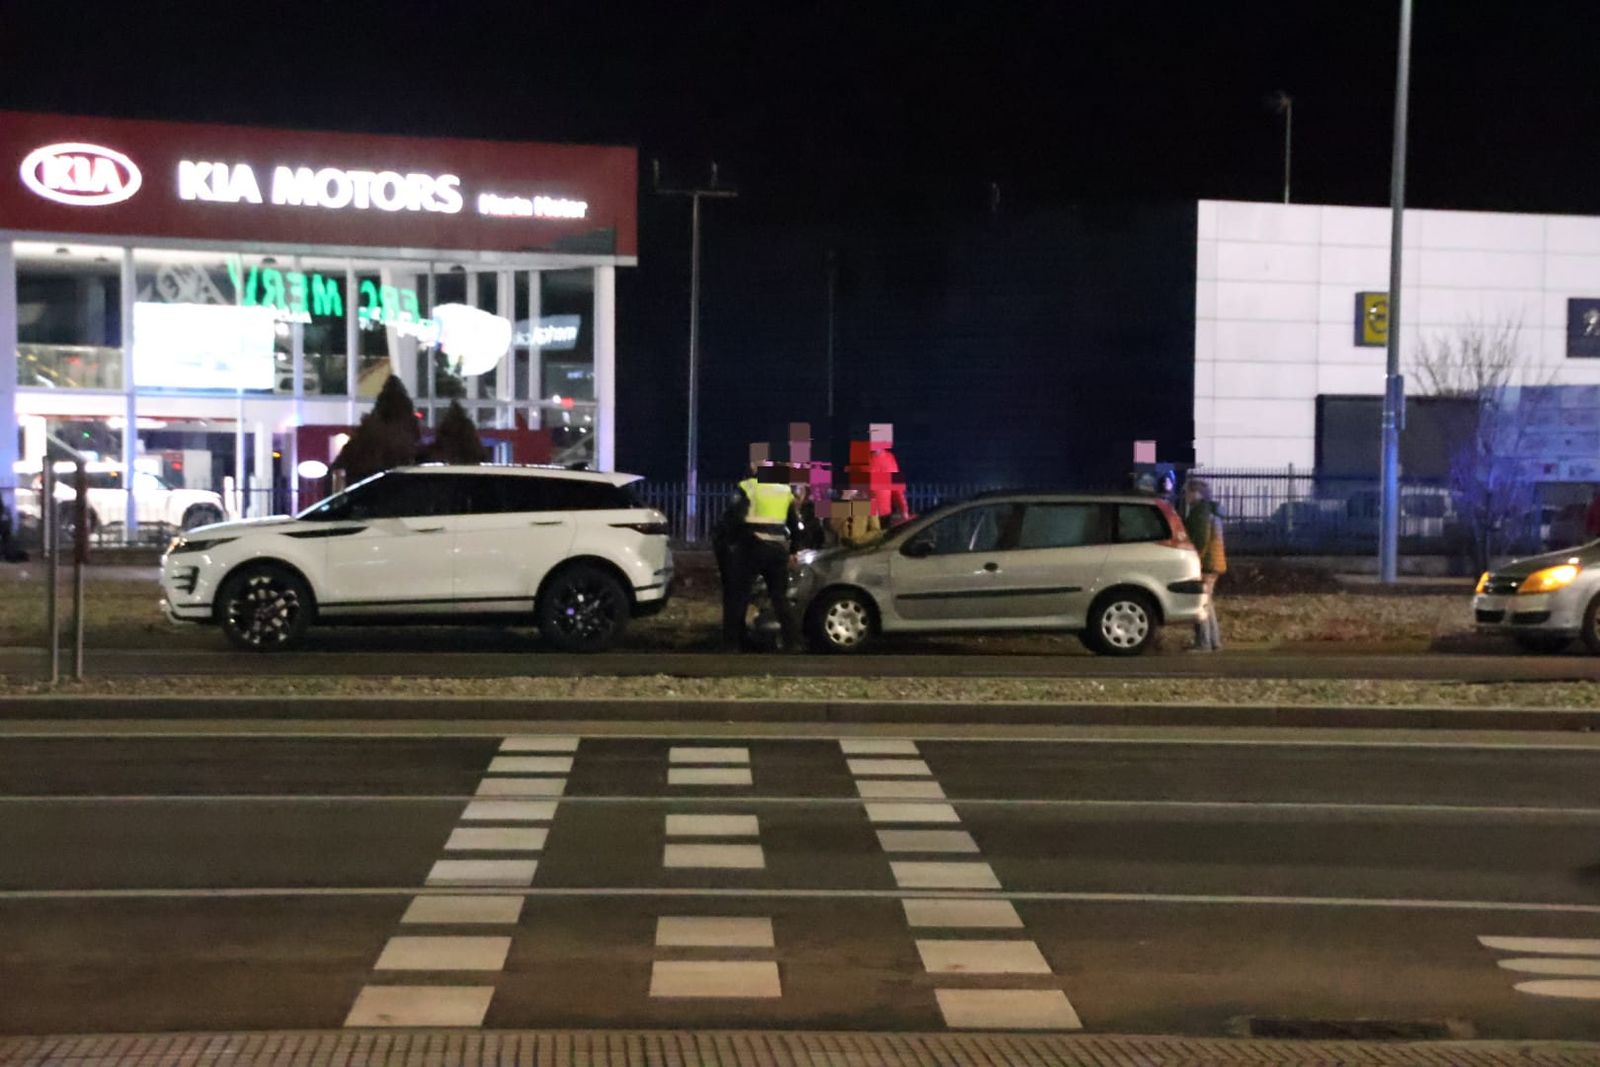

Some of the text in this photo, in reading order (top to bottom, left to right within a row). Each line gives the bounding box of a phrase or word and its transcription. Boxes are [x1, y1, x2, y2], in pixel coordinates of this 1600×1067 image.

[43, 156, 123, 193] KIA
[178, 160, 463, 214] KIA MOTORS
